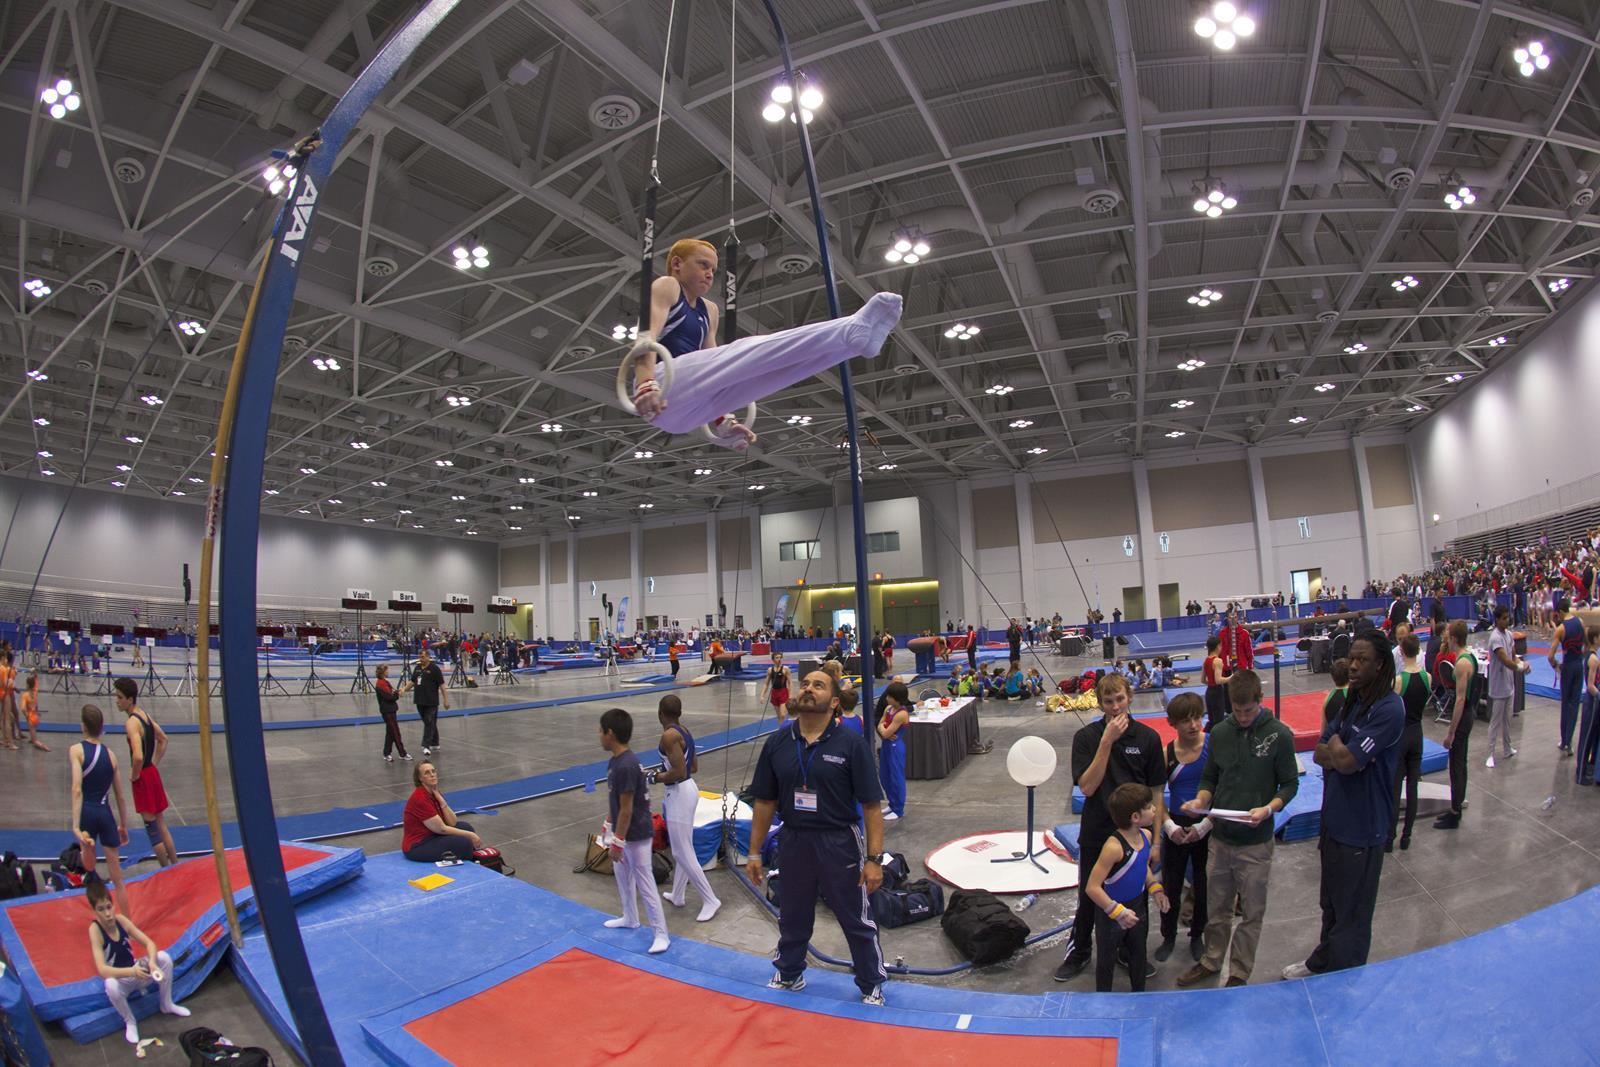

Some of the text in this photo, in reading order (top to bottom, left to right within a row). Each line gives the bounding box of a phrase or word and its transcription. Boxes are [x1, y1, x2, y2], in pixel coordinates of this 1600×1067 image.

[352, 590, 370, 600] Vault
[399, 592, 414, 601] Bars
[451, 596, 468, 605] Beam
[497, 597, 511, 605] Floor
